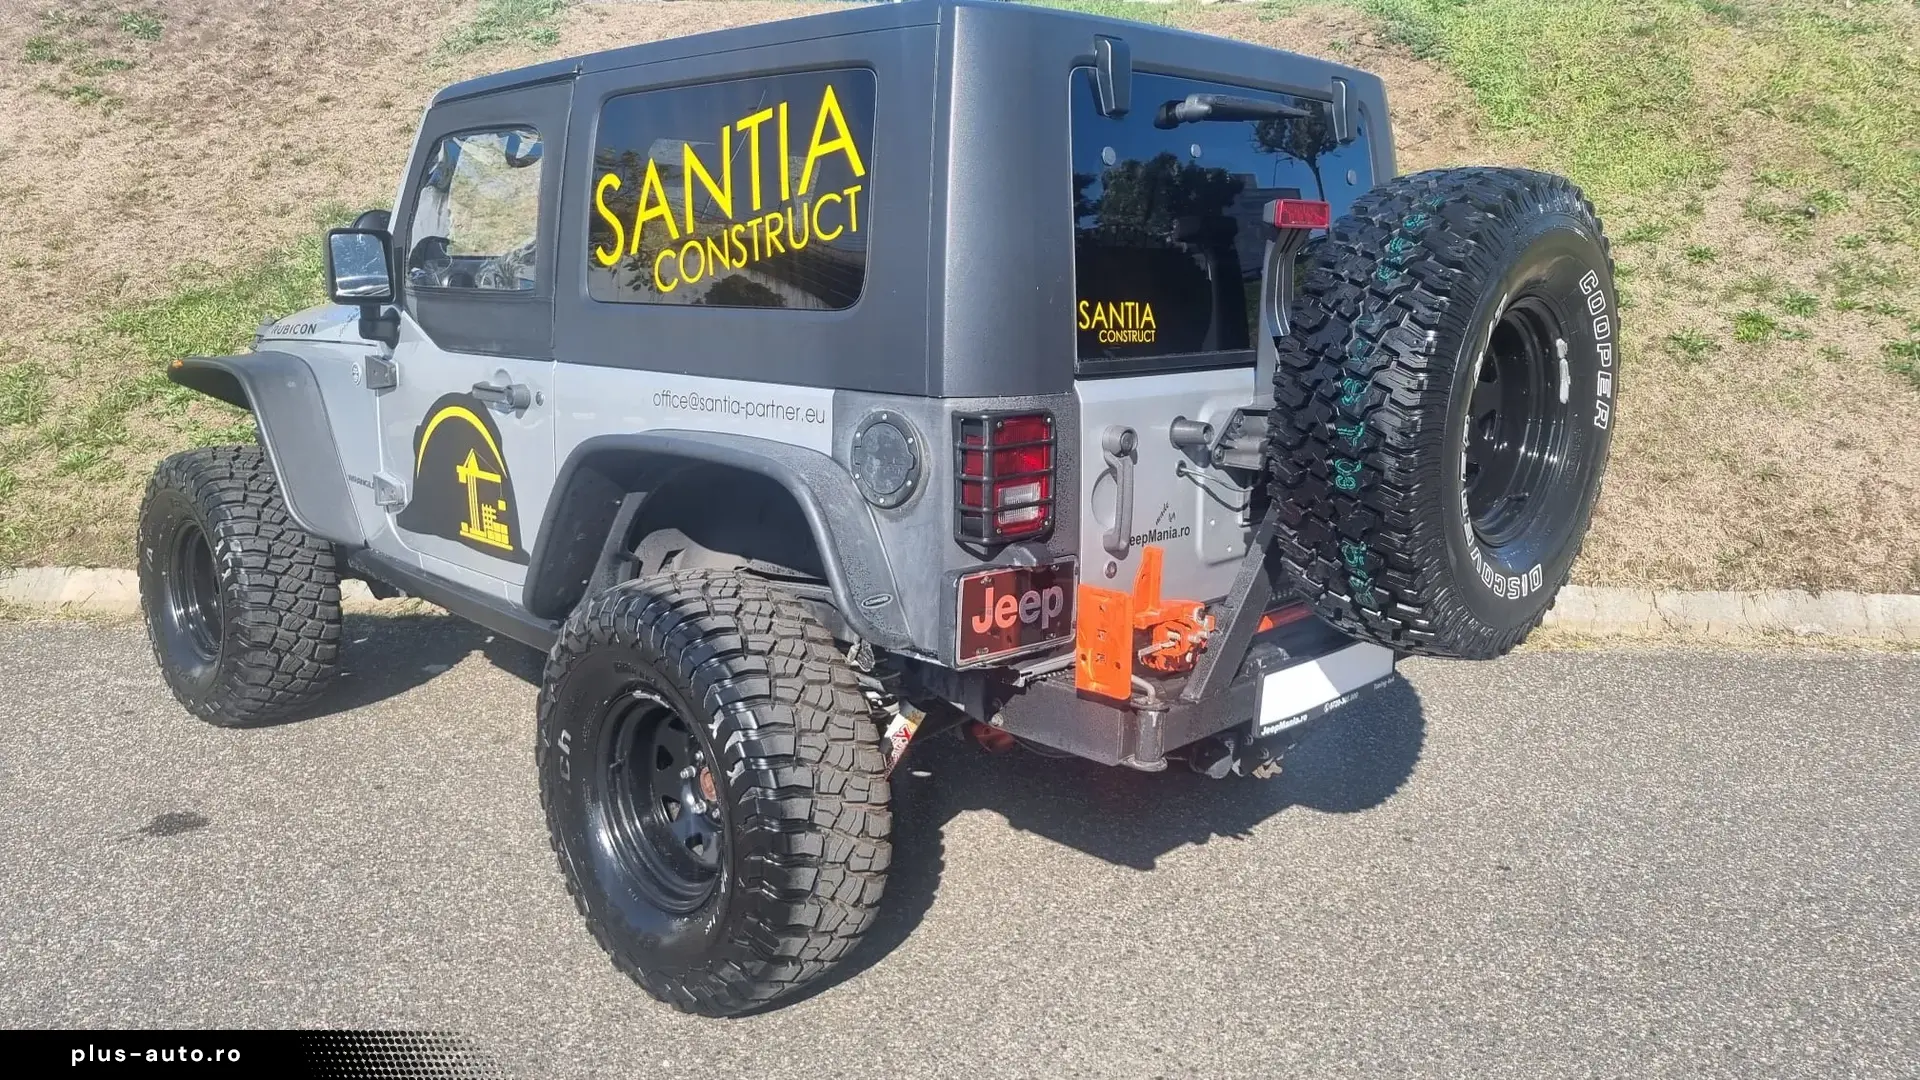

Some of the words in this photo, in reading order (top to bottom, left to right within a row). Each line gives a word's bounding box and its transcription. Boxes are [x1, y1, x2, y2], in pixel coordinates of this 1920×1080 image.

[595, 84, 866, 267] SANTIA
[653, 184, 863, 293] CONSTRUCT
[270, 323, 317, 335] RUBICON
[1078, 300, 1156, 330] SANTIA
[1098, 329, 1157, 344] CONSTRUCT
[1579, 269, 1613, 430] COOPER
[652, 389, 826, 424] office@santia-partner.eu
[1129, 525, 1191, 547] eepMania.ro
[971, 585, 1064, 634] Jeep
